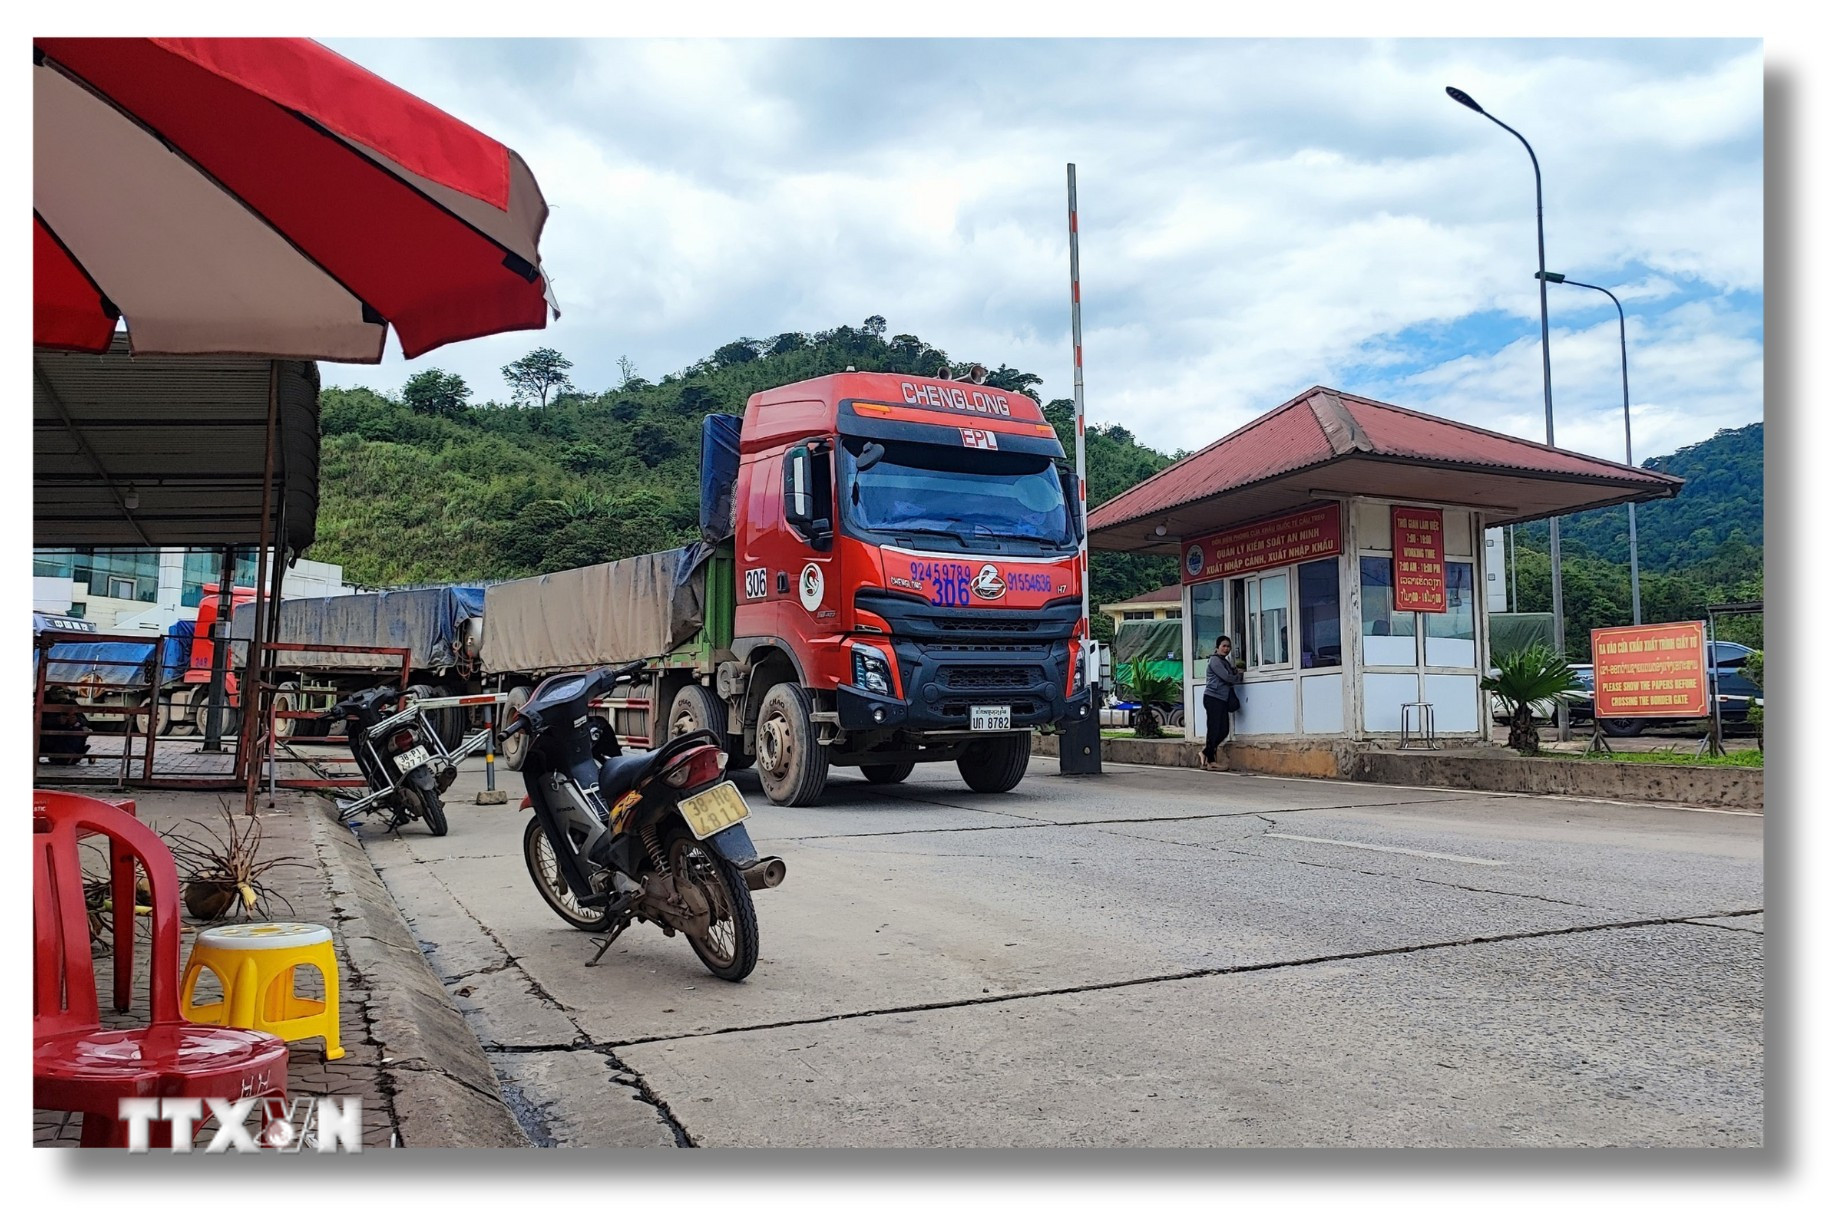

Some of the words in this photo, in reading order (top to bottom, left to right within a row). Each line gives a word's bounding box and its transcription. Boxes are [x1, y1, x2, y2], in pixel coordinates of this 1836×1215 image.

[901, 382, 1010, 416] CHENGLONG
[961, 429, 997, 449] EPL
[1266, 534, 1284, 548] SOÁT
[1287, 532, 1298, 543] AN
[1300, 528, 1319, 540] NINH
[910, 561, 971, 583] 92459789
[746, 569, 767, 597] 306
[931, 578, 970, 607] 306
[1602, 682, 1622, 692] PLEASE
[1623, 681, 1639, 691] SHOW
[1640, 680, 1650, 690] THE
[1651, 680, 1673, 690] PAPERS
[1674, 678, 1697, 689] BEFORE
[1611, 696, 1638, 707] CROSSING
[1639, 696, 1649, 705] THE
[1650, 695, 1672, 705] BORDER
[1673, 694, 1688, 704] GATE
[987, 717, 1009, 729] 8782
